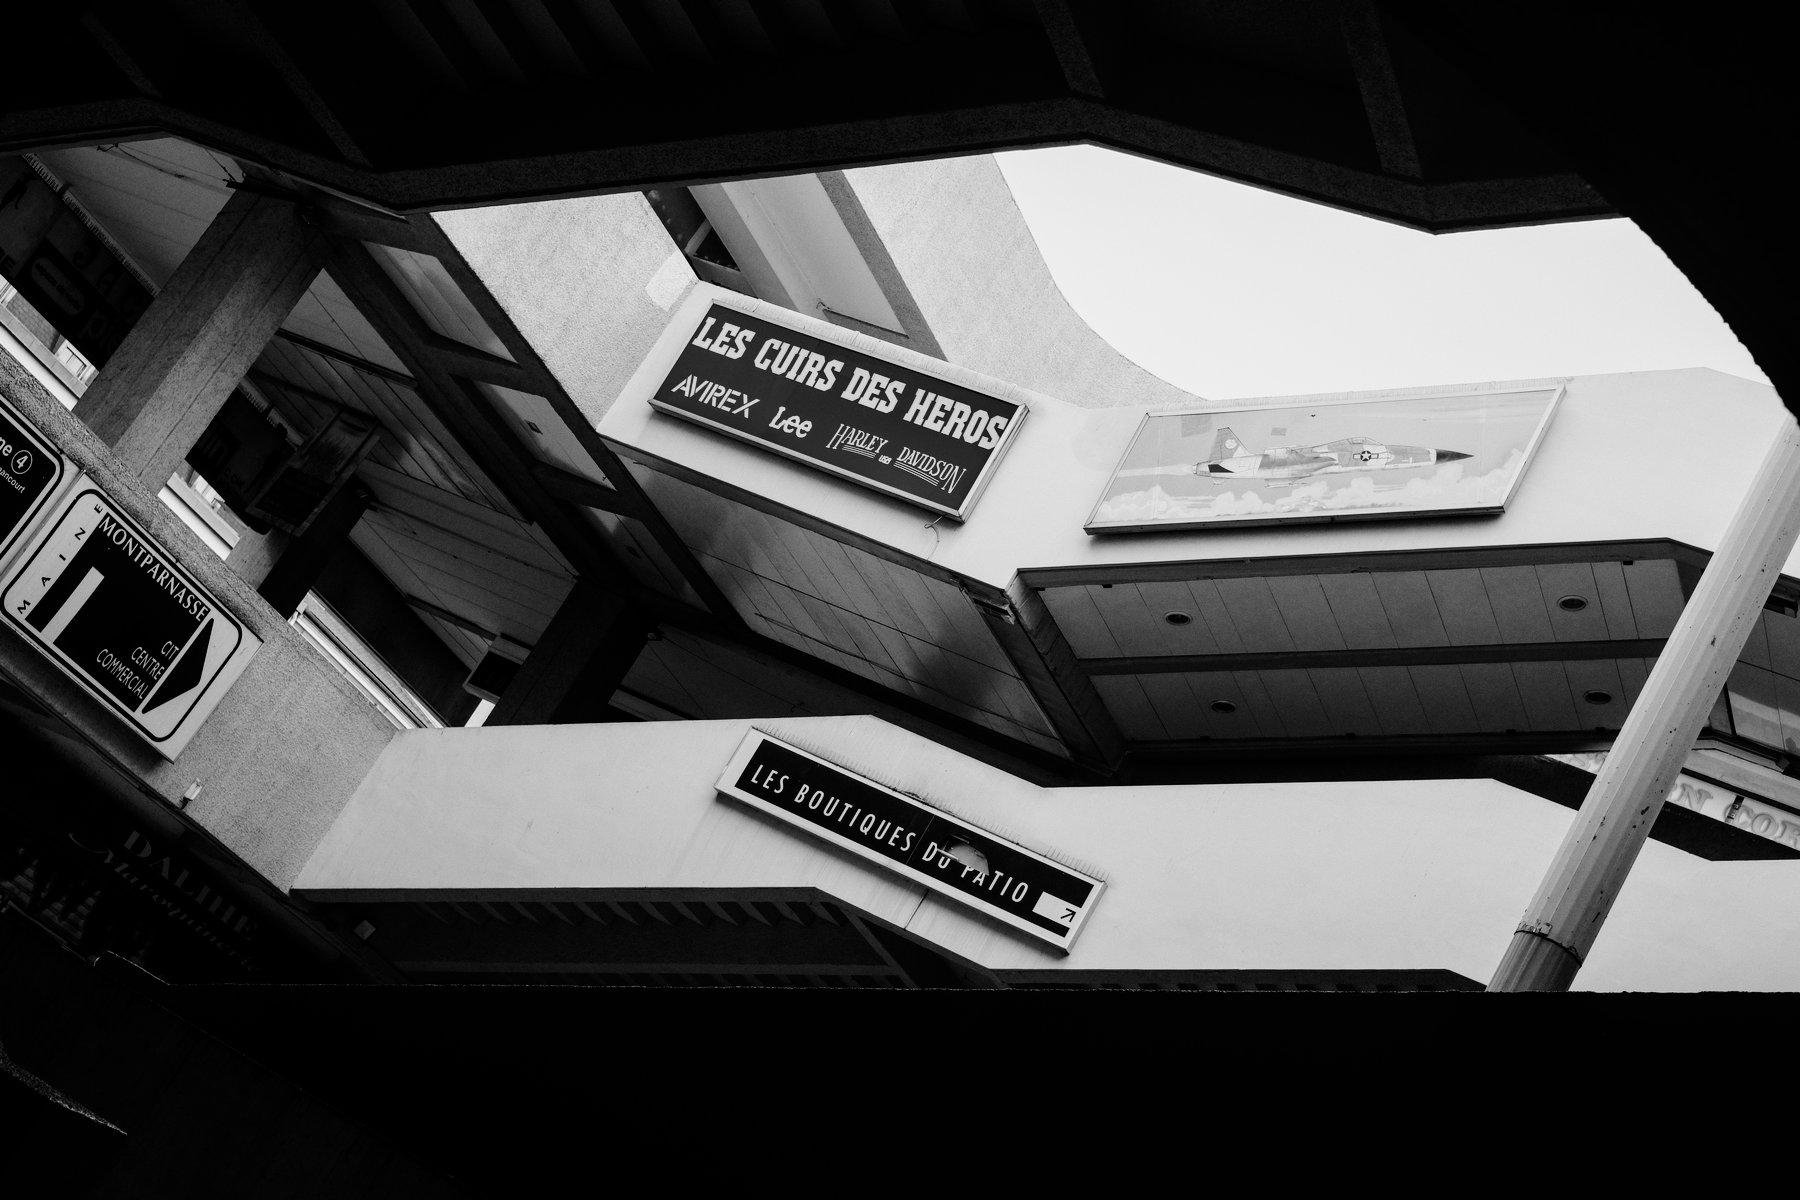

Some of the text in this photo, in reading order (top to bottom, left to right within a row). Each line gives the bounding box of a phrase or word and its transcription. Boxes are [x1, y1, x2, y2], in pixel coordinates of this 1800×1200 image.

[670, 374, 813, 439] AVIREX Lee
[691, 315, 1010, 451] LES CUIRS DES HEROS
[0, 467, 26, 494] ancourt
[825, 423, 968, 494] HARLEY DAVIDSON
[99, 514, 212, 623] MONTPARNASSE
[96, 649, 150, 700] COMMERCIAL
[131, 646, 166, 681] CENTRE
[750, 764, 1030, 905] LES BOUTIQUES DU PATIO
